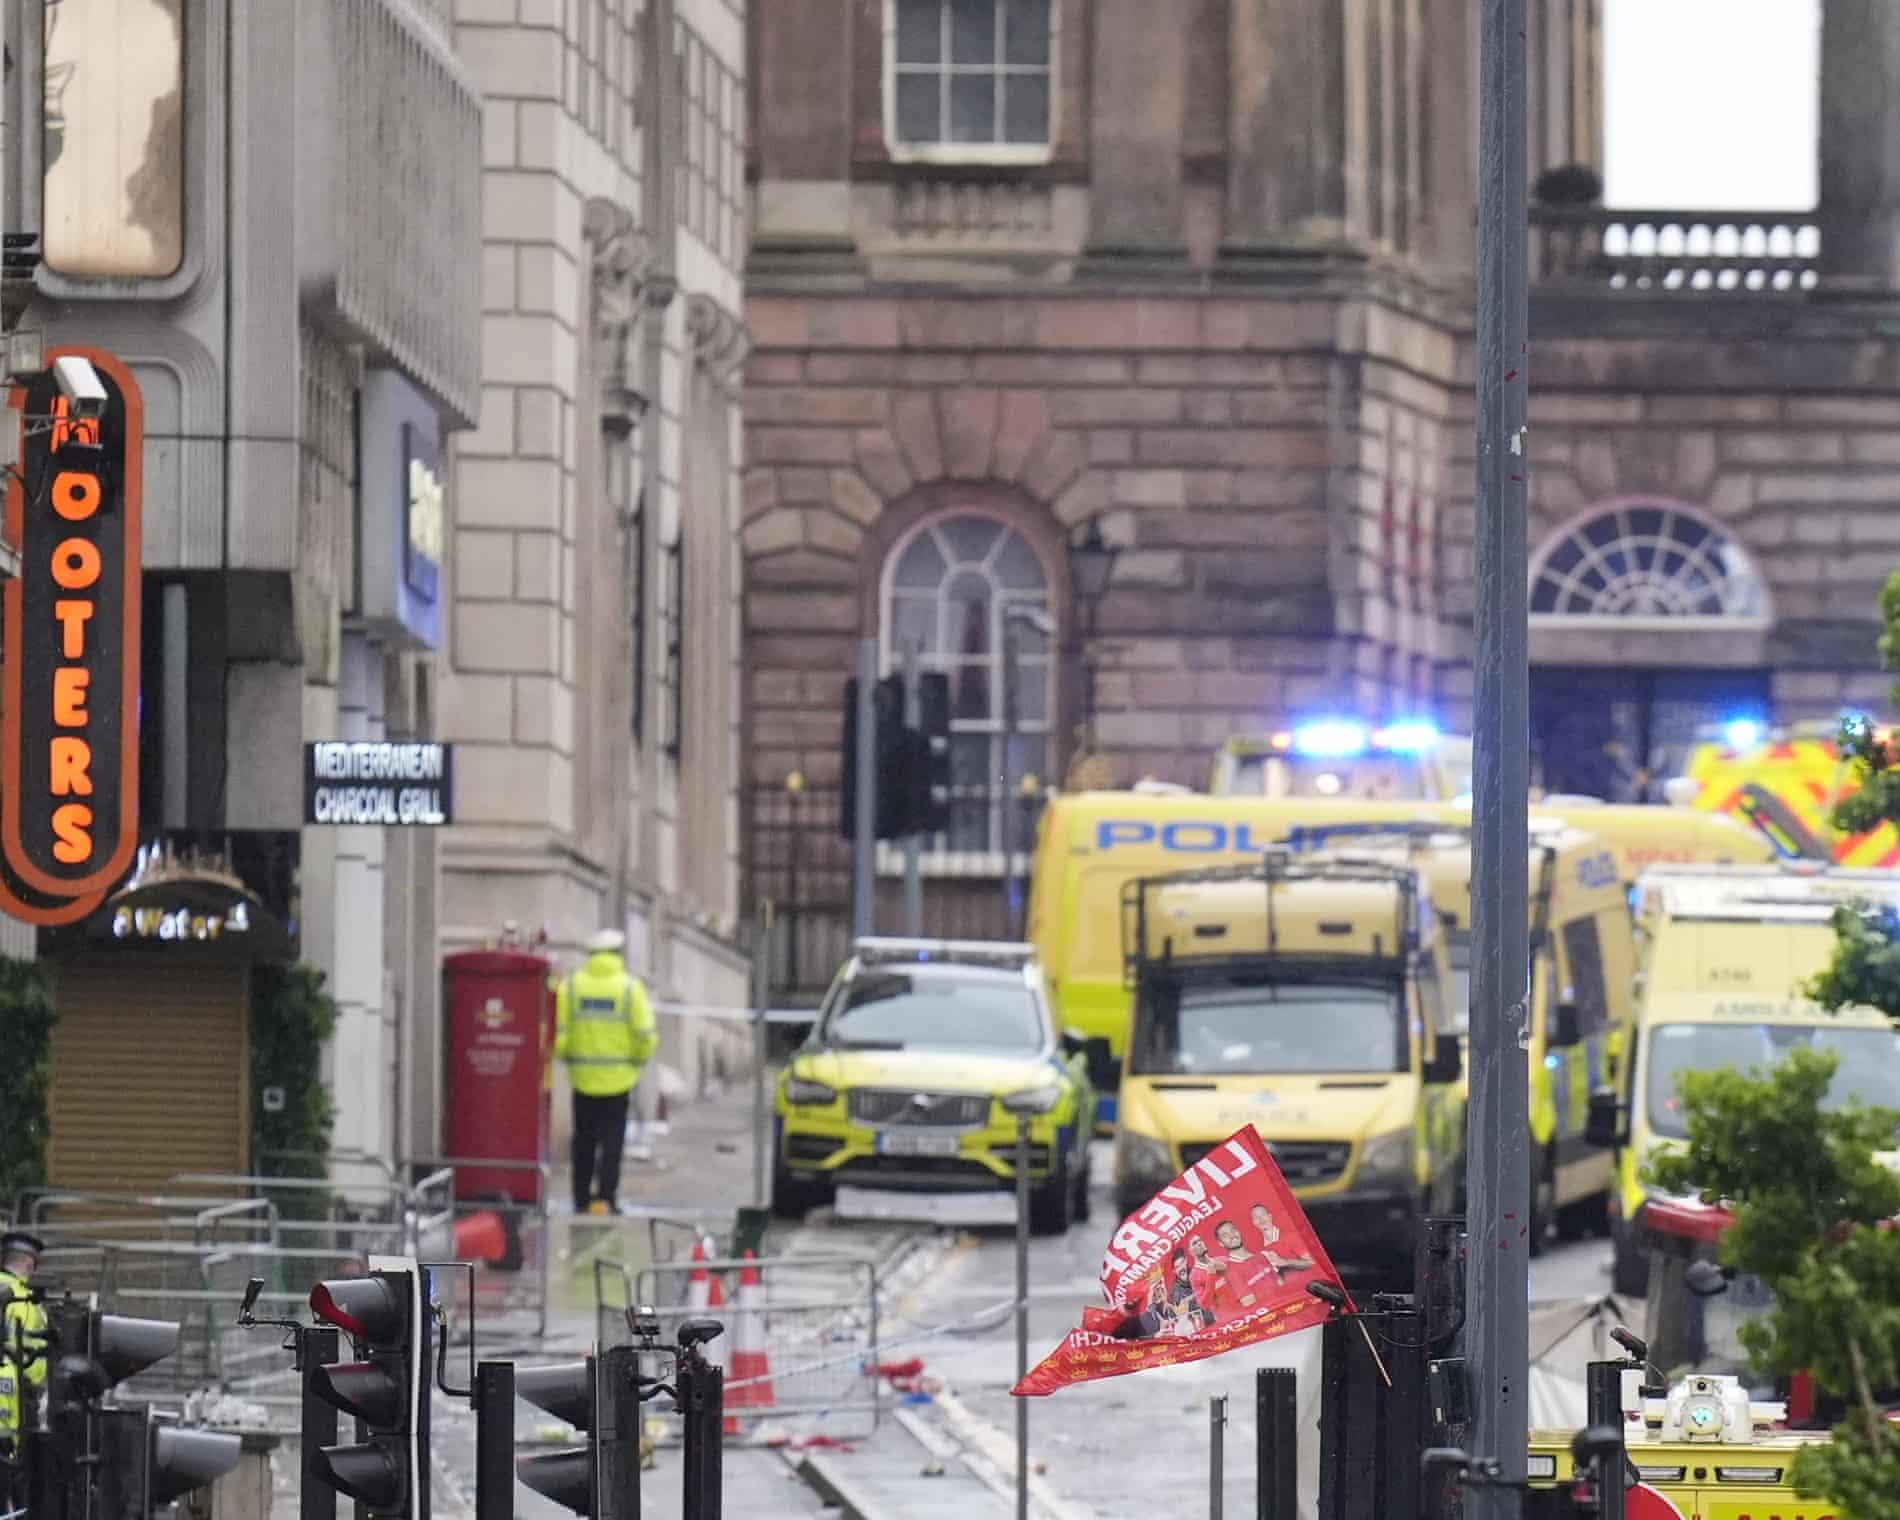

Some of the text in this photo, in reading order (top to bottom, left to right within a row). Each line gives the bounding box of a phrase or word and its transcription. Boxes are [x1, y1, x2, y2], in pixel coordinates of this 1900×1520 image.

[314, 742, 444, 779] MEDITERRANEAN
[314, 786, 445, 824] CHARCOAL GRILL
[1098, 820, 1400, 853] POLI
